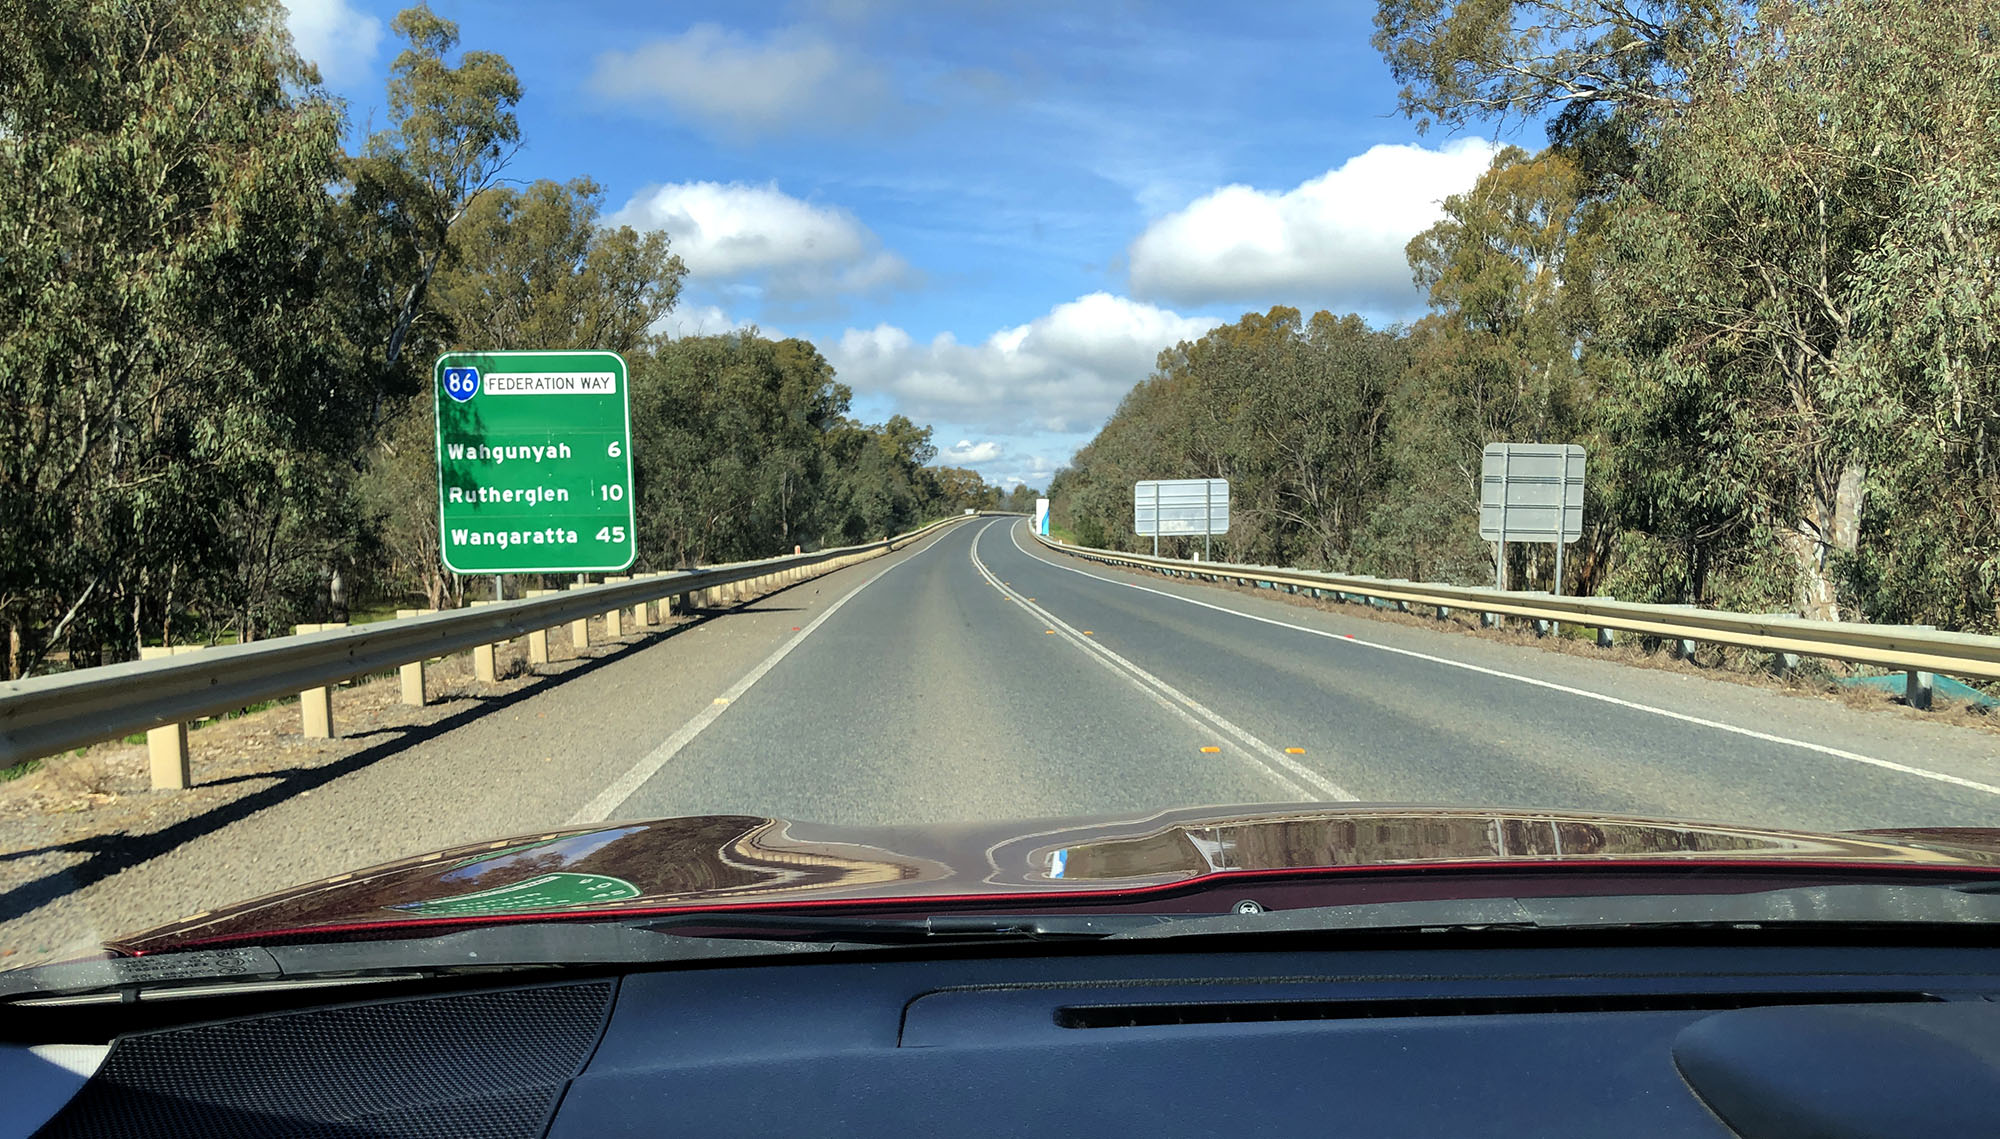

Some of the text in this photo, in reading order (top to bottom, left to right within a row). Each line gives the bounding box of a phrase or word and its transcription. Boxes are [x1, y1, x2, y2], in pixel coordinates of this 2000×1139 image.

[449, 372, 474, 393] 86
[488, 376, 610, 391] FEDERATION WAY
[447, 441, 622, 464] Wahgunyah 6
[449, 484, 624, 507] Rutherglen 10
[451, 526, 626, 550] Wangaratta 45
